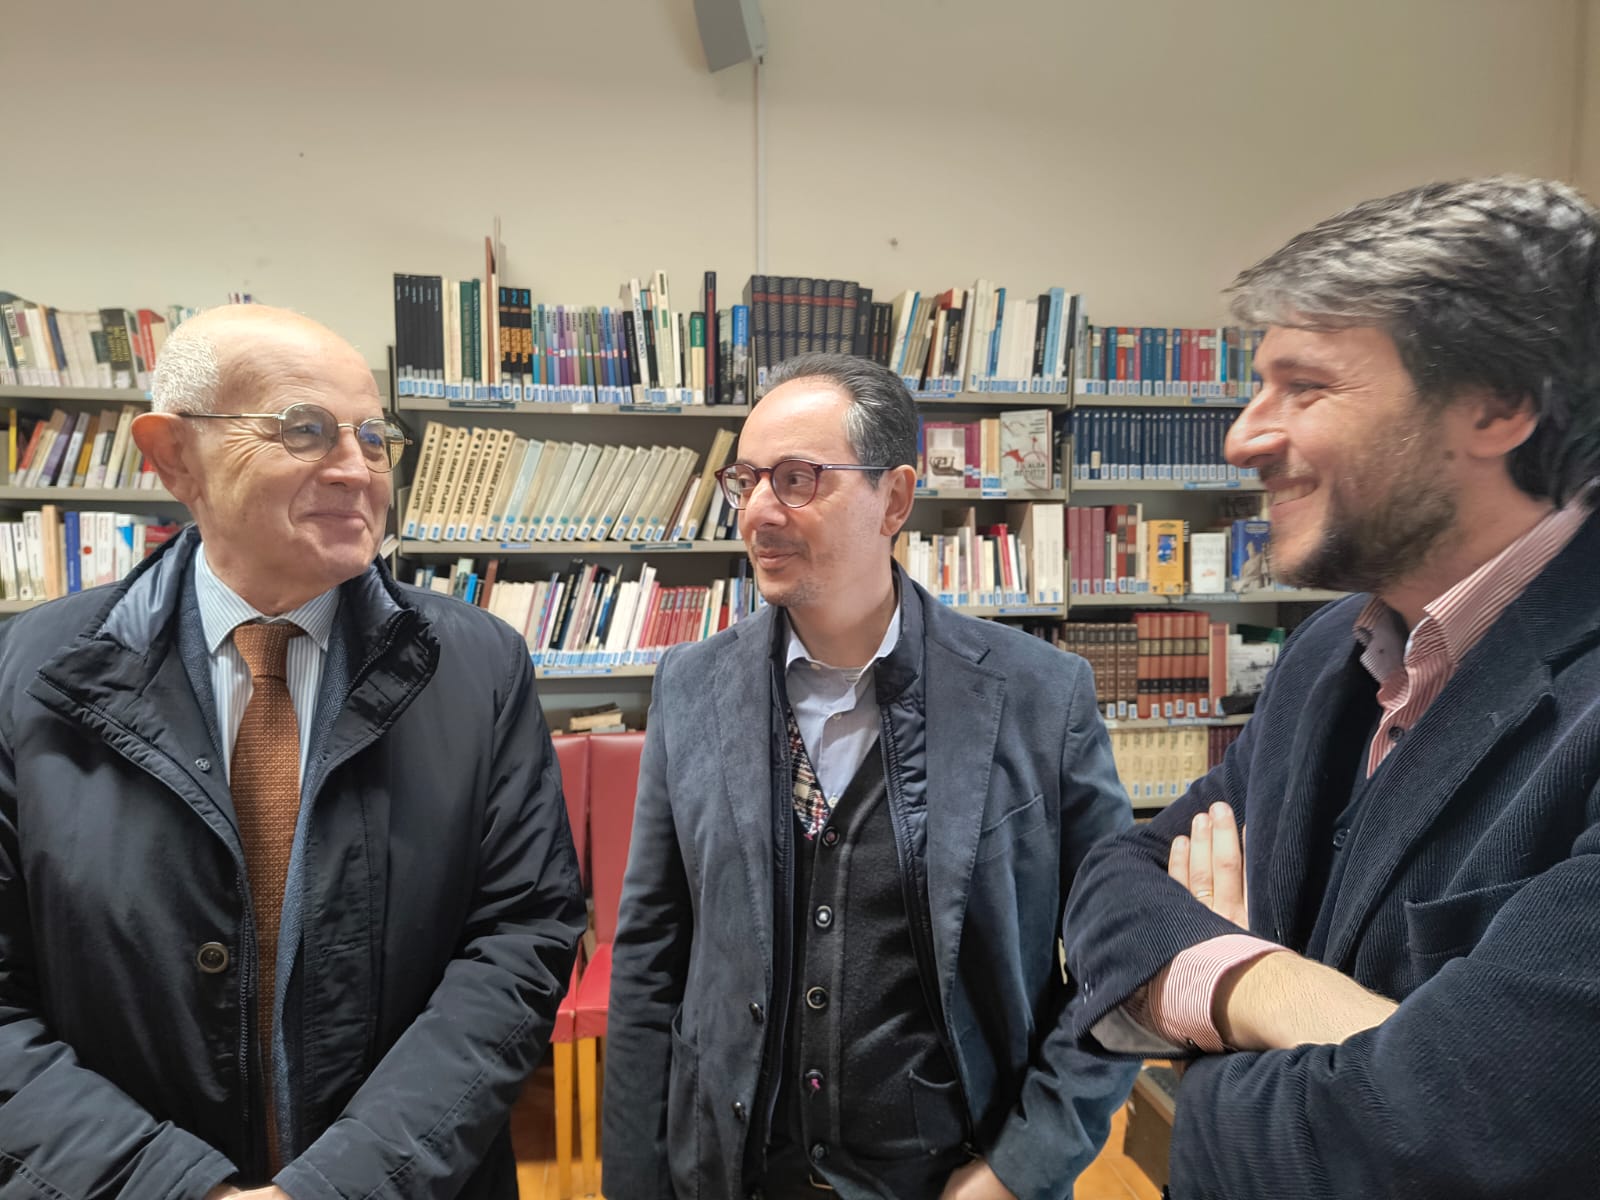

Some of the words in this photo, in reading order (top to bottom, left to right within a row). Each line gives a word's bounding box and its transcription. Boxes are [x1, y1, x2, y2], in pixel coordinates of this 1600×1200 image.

[511, 289, 518, 304] 2
[638, 335, 647, 359] MONDO
[431, 426, 437, 435] 1
[444, 431, 452, 439] 2
[476, 433, 483, 441] 4
[419, 454, 432, 478] GRANDE
[433, 457, 446, 482] GRANDE
[447, 458, 459, 483] GRANDE
[463, 458, 476, 484] GRANDE
[476, 459, 489, 484] GRANDE
[490, 461, 503, 485] GRANDE
[412, 479, 425, 510] ATLANTE
[425, 484, 438, 513] ATLANTE
[438, 485, 451, 514] ATLANTE
[454, 485, 468, 514] ATLANTE
[467, 485, 480, 514] ATLANTE
[482, 486, 495, 516] ATLANTE
